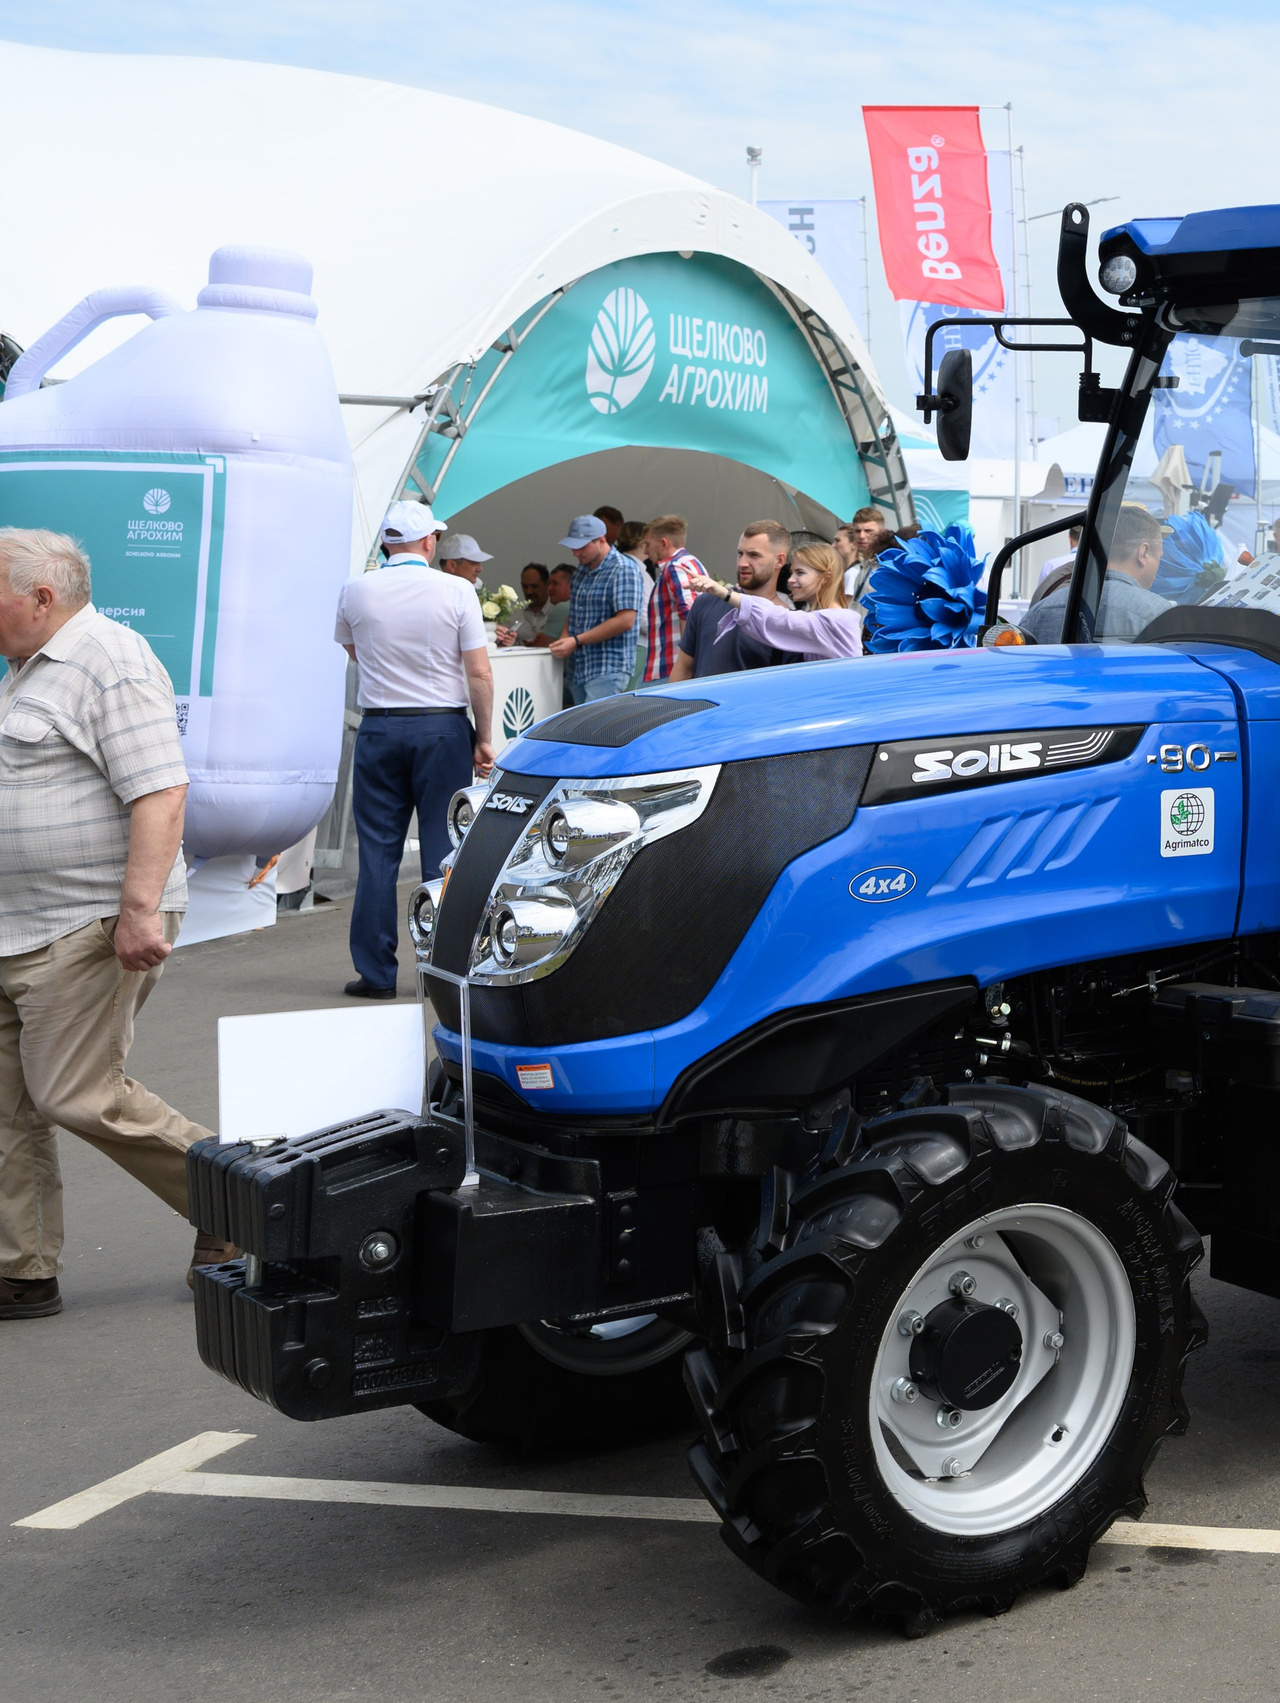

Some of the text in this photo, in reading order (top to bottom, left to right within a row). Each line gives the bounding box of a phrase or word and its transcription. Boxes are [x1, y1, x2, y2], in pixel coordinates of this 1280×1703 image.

[669, 312, 767, 368] ЩЕЛКОВО
[659, 362, 769, 414] АГРОХИМ
[127, 520, 184, 531] ЩЕЛКОВО
[127, 531, 183, 542] АГРОХИМ
[98, 606, 146, 617] версия
[1164, 838, 1210, 852] Agrimatco
[858, 873, 907, 896] 4x4
